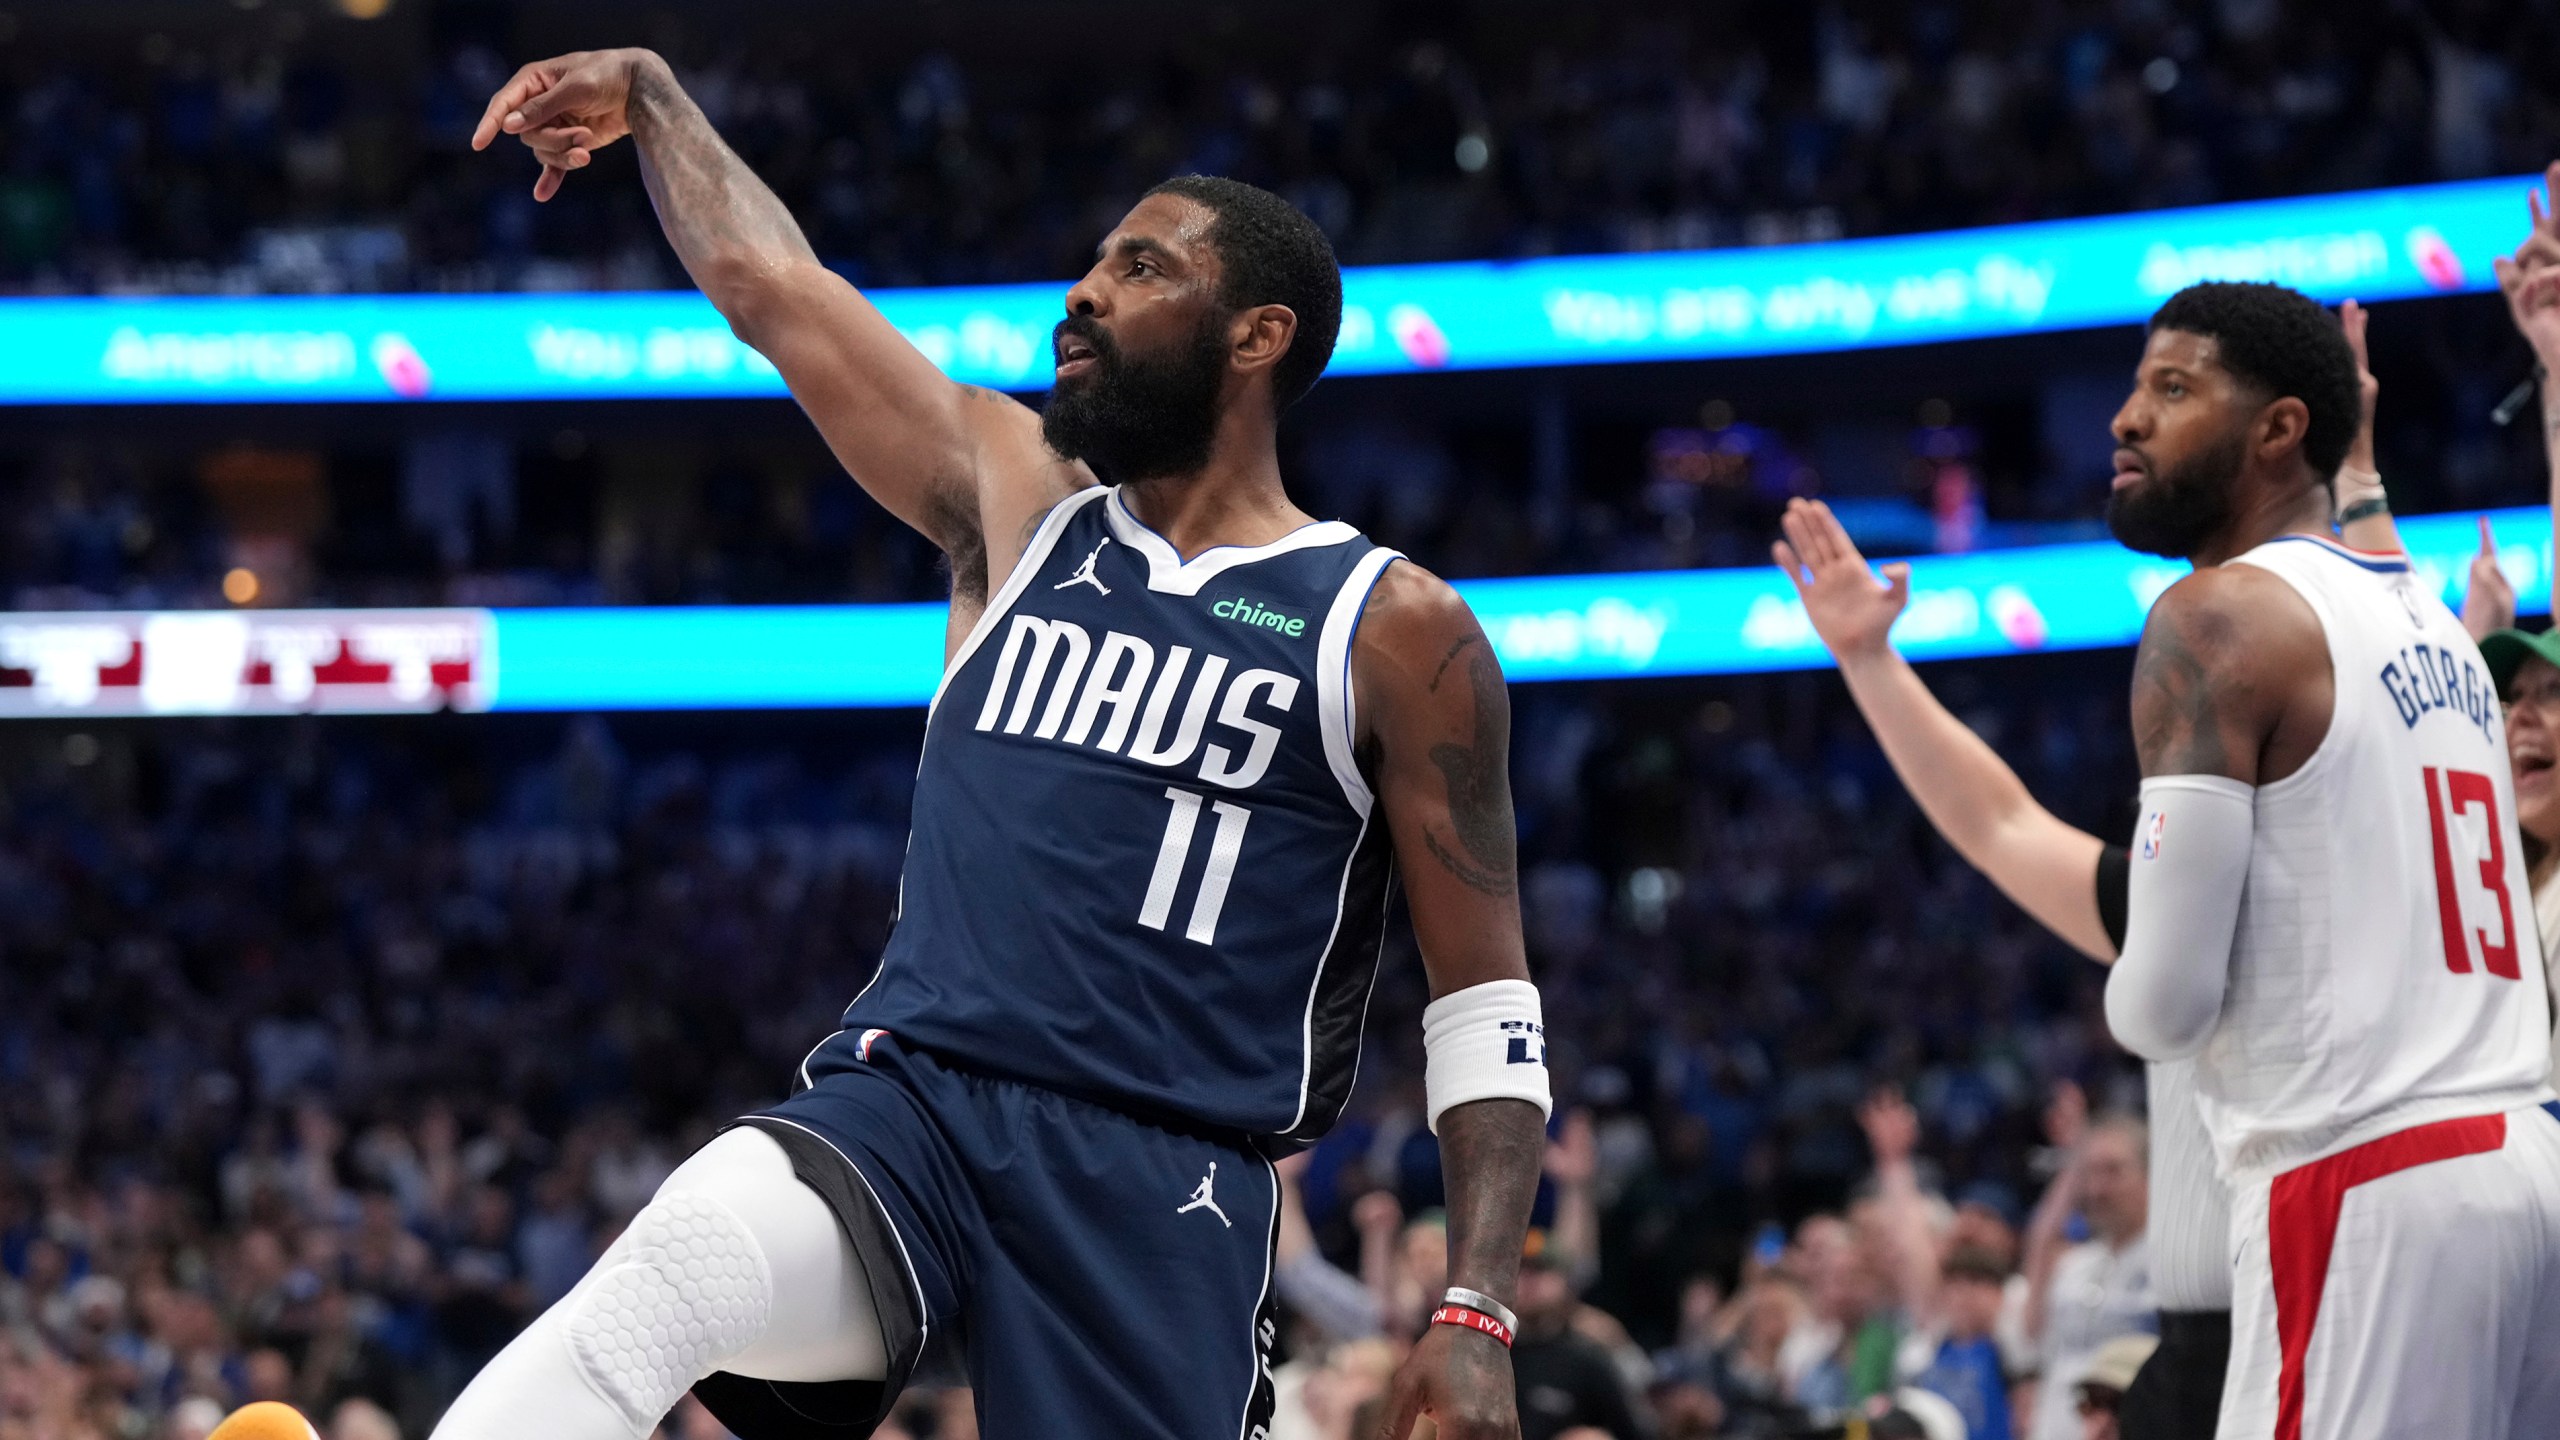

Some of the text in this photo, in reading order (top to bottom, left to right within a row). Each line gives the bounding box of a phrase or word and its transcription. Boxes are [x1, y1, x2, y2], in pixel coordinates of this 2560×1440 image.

[1212, 597, 1305, 637] chime
[974, 614, 1300, 789] MAVS
[2380, 643, 2494, 745] GEORGE
[1137, 786, 1252, 946] 11
[2422, 766, 2523, 980] 13
[1478, 1316, 1504, 1337] KAI
